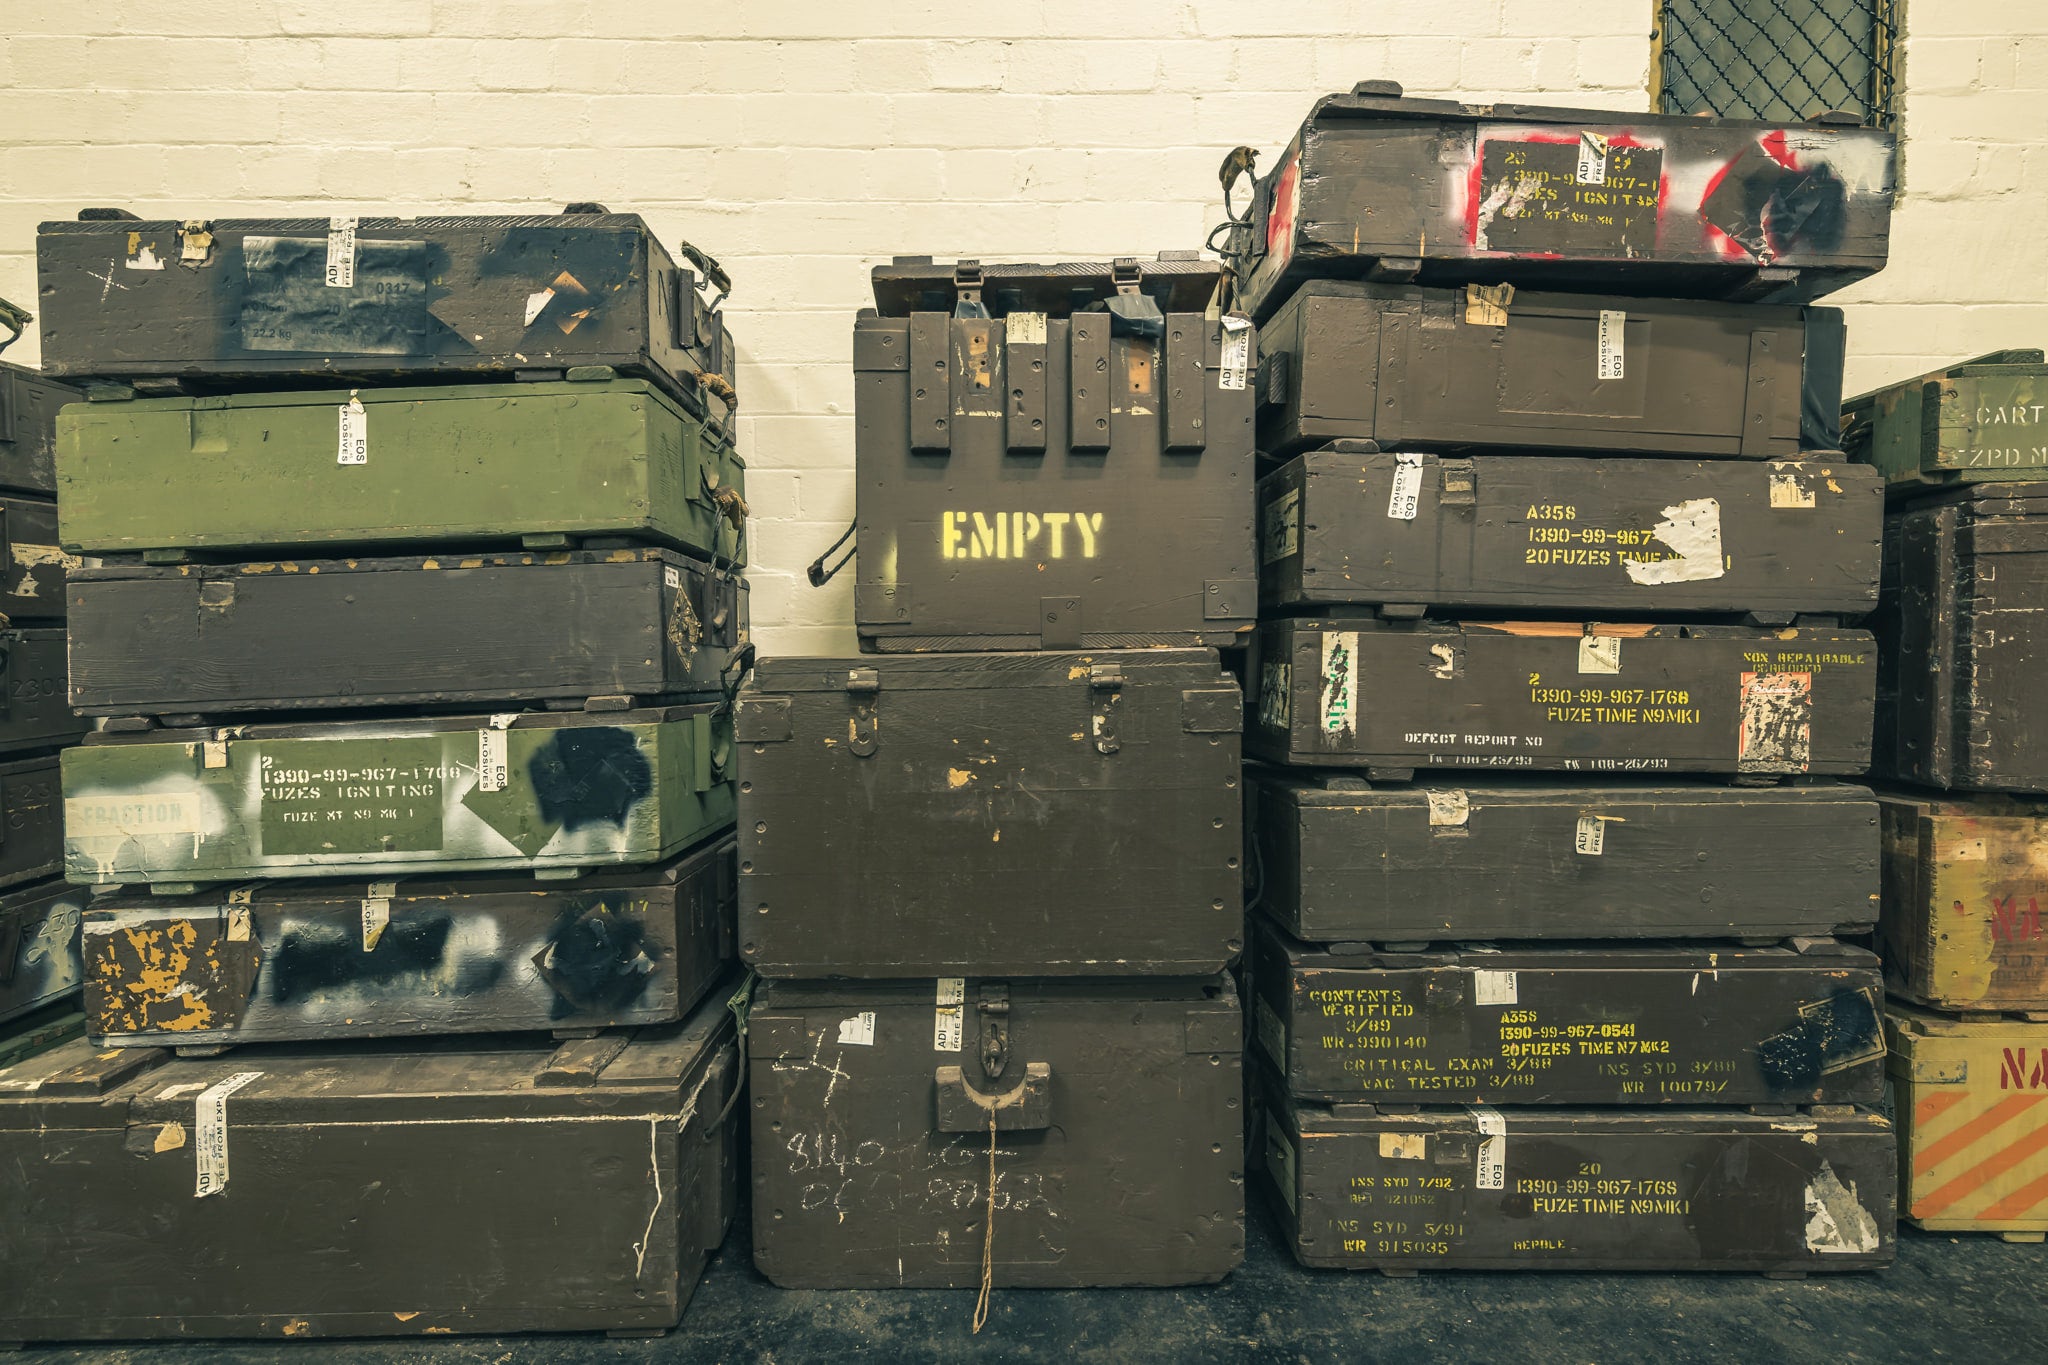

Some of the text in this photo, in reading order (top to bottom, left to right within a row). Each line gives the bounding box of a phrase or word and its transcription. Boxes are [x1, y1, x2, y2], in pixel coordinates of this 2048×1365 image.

[1579, 161, 1589, 180] ADI
[328, 265, 338, 285] ADI
[1600, 313, 1609, 378] EXPLOSIVES
[1238, 361, 1246, 388] FREE
[1613, 354, 1622, 378] EOS
[1222, 368, 1232, 387] ADI
[1976, 405, 2045, 425] CART
[356, 439, 365, 462] EOS
[1404, 495, 1416, 518] EOS
[943, 511, 1104, 559] EMPTY
[1404, 733, 1456, 744] DEFECT
[1464, 734, 1517, 746] REPORT
[261, 756, 273, 769] 2
[496, 765, 506, 788] EOS
[338, 784, 434, 798] IGNITING
[83, 802, 182, 826] FRACTION
[284, 812, 318, 823] FUZE
[1578, 832, 1588, 851] ADI
[1594, 825, 1602, 852] FREE
[1309, 990, 1402, 1002] CONTENTS
[1322, 1004, 1414, 1017] VERIFIED
[938, 1030, 948, 1049] ADI
[953, 1022, 961, 1049] FREE
[1500, 1024, 1636, 1041] 1390-99-967-0541
[1578, 1041, 1614, 1055] TIME
[1344, 1059, 1436, 1072] CRITICAL
[1448, 1058, 1494, 1070] EXAM
[1408, 1076, 1476, 1090] TESTED
[1492, 1164, 1503, 1187] EOS
[1578, 1162, 1602, 1176] 20
[200, 1172, 210, 1194] ADI
[1351, 1177, 1376, 1188] INS
[1383, 1177, 1410, 1188] SYD
